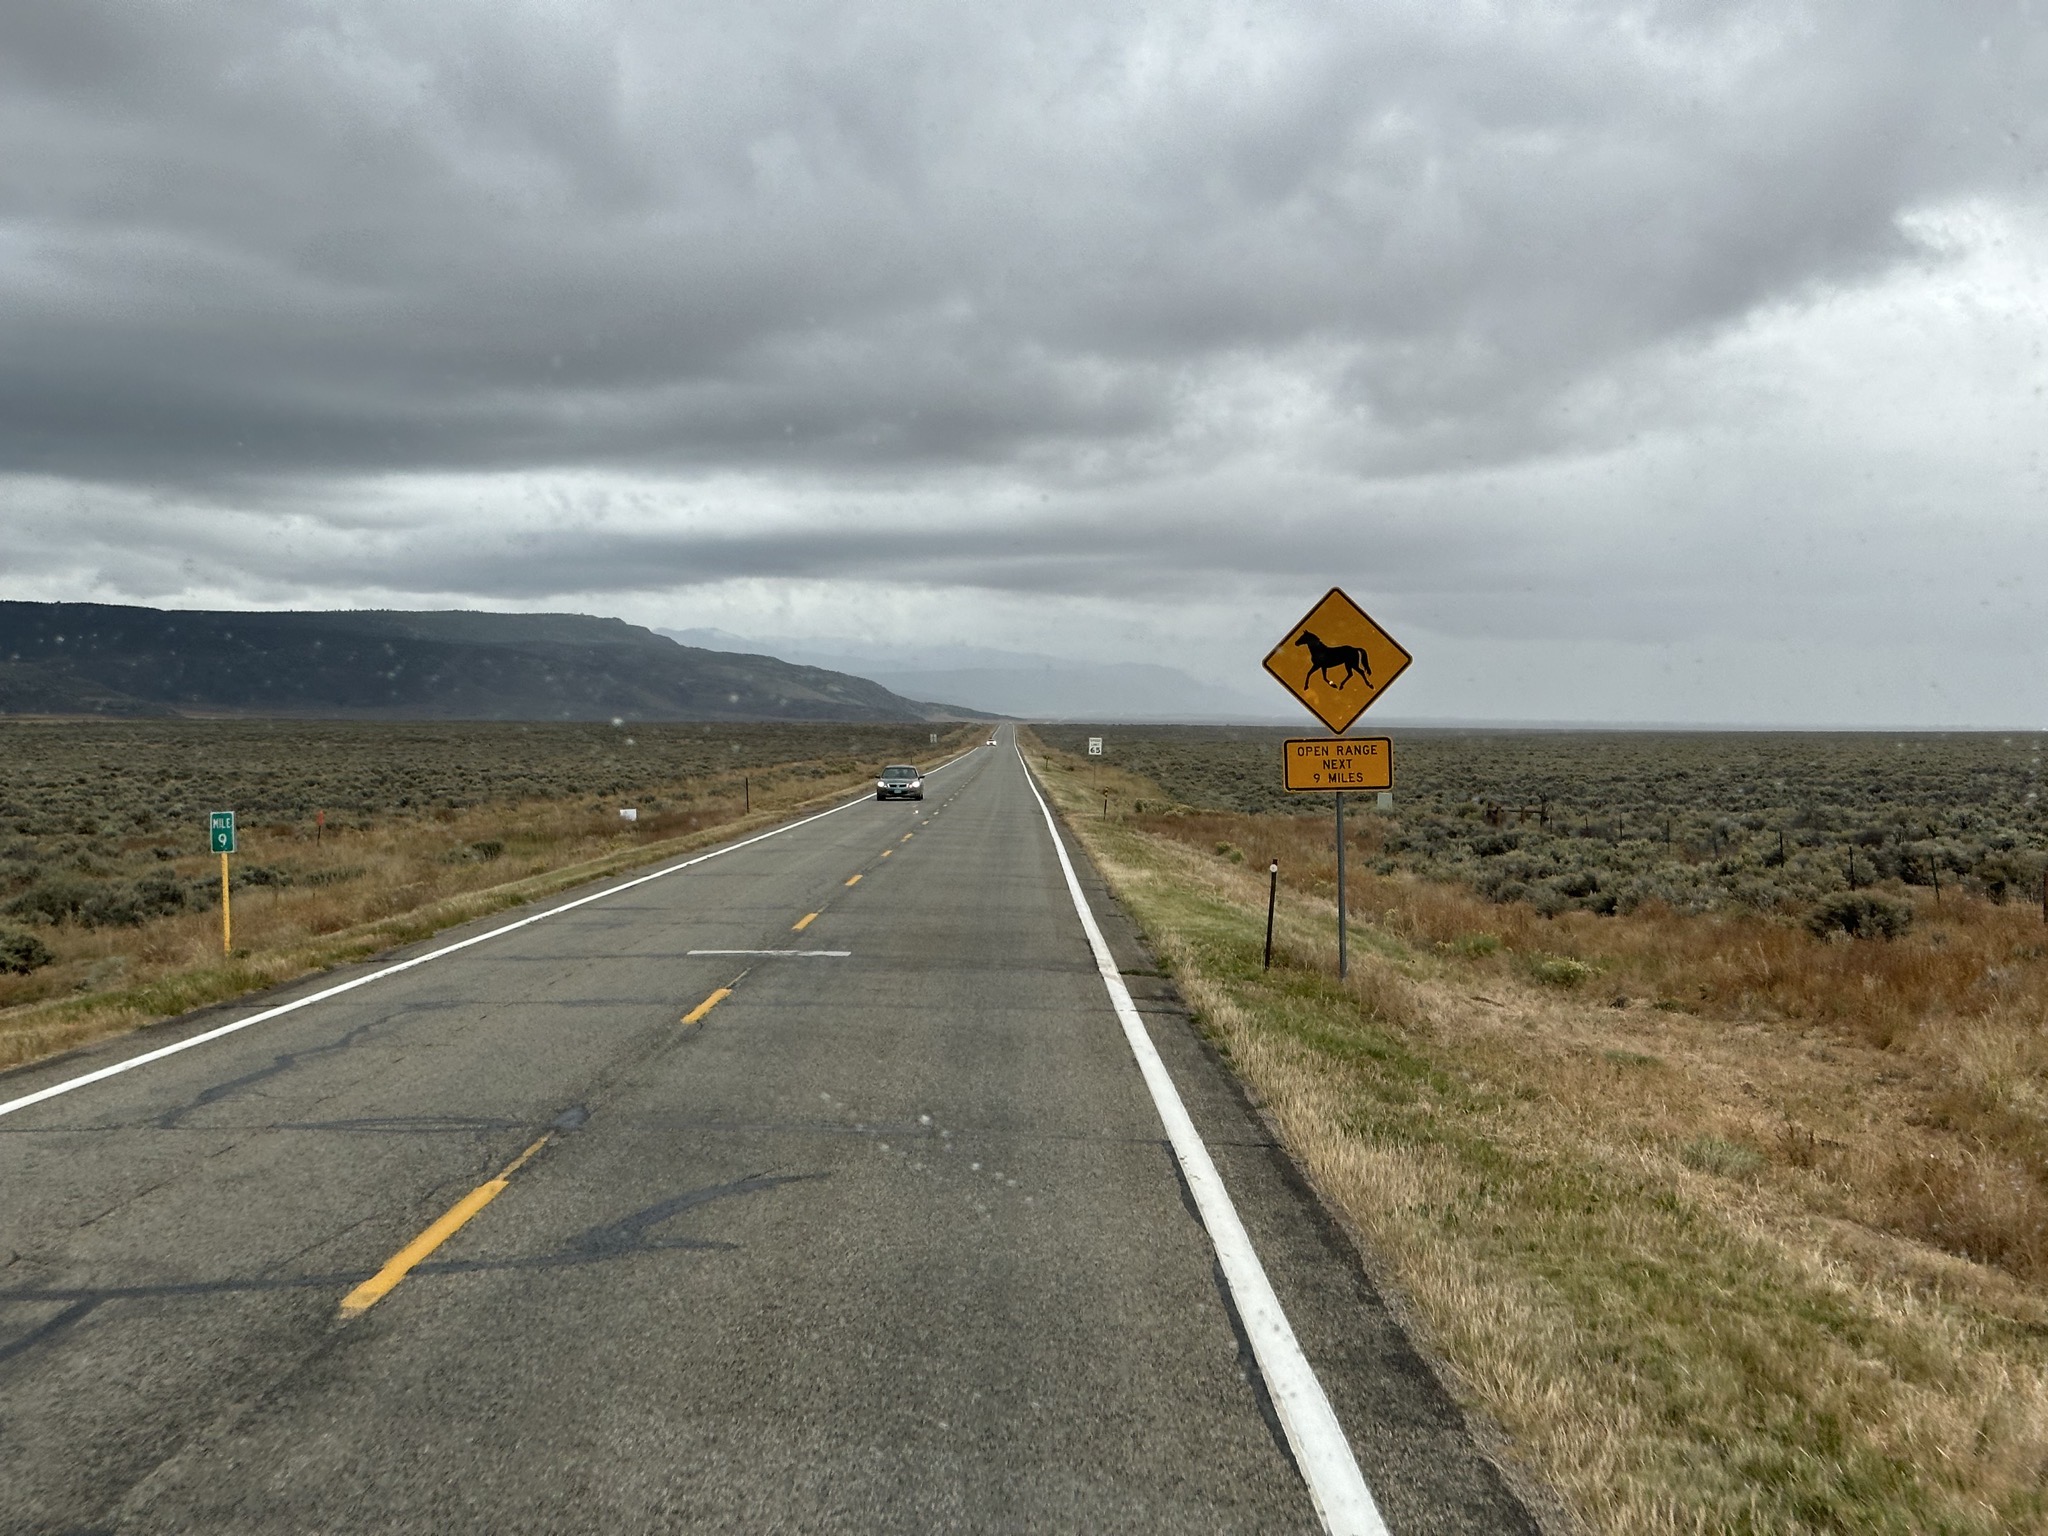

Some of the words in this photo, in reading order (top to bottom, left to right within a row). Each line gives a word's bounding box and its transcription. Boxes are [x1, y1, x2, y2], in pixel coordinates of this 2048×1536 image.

[1090, 746, 1101, 754] 65
[1297, 746, 1329, 756] OPEN
[1336, 745, 1377, 755] RANGE
[1323, 759, 1353, 769] NEXT
[1313, 773, 1320, 783] 9
[1328, 772, 1363, 783] MILES
[213, 818, 230, 829] MILE
[218, 833, 227, 848] 9
